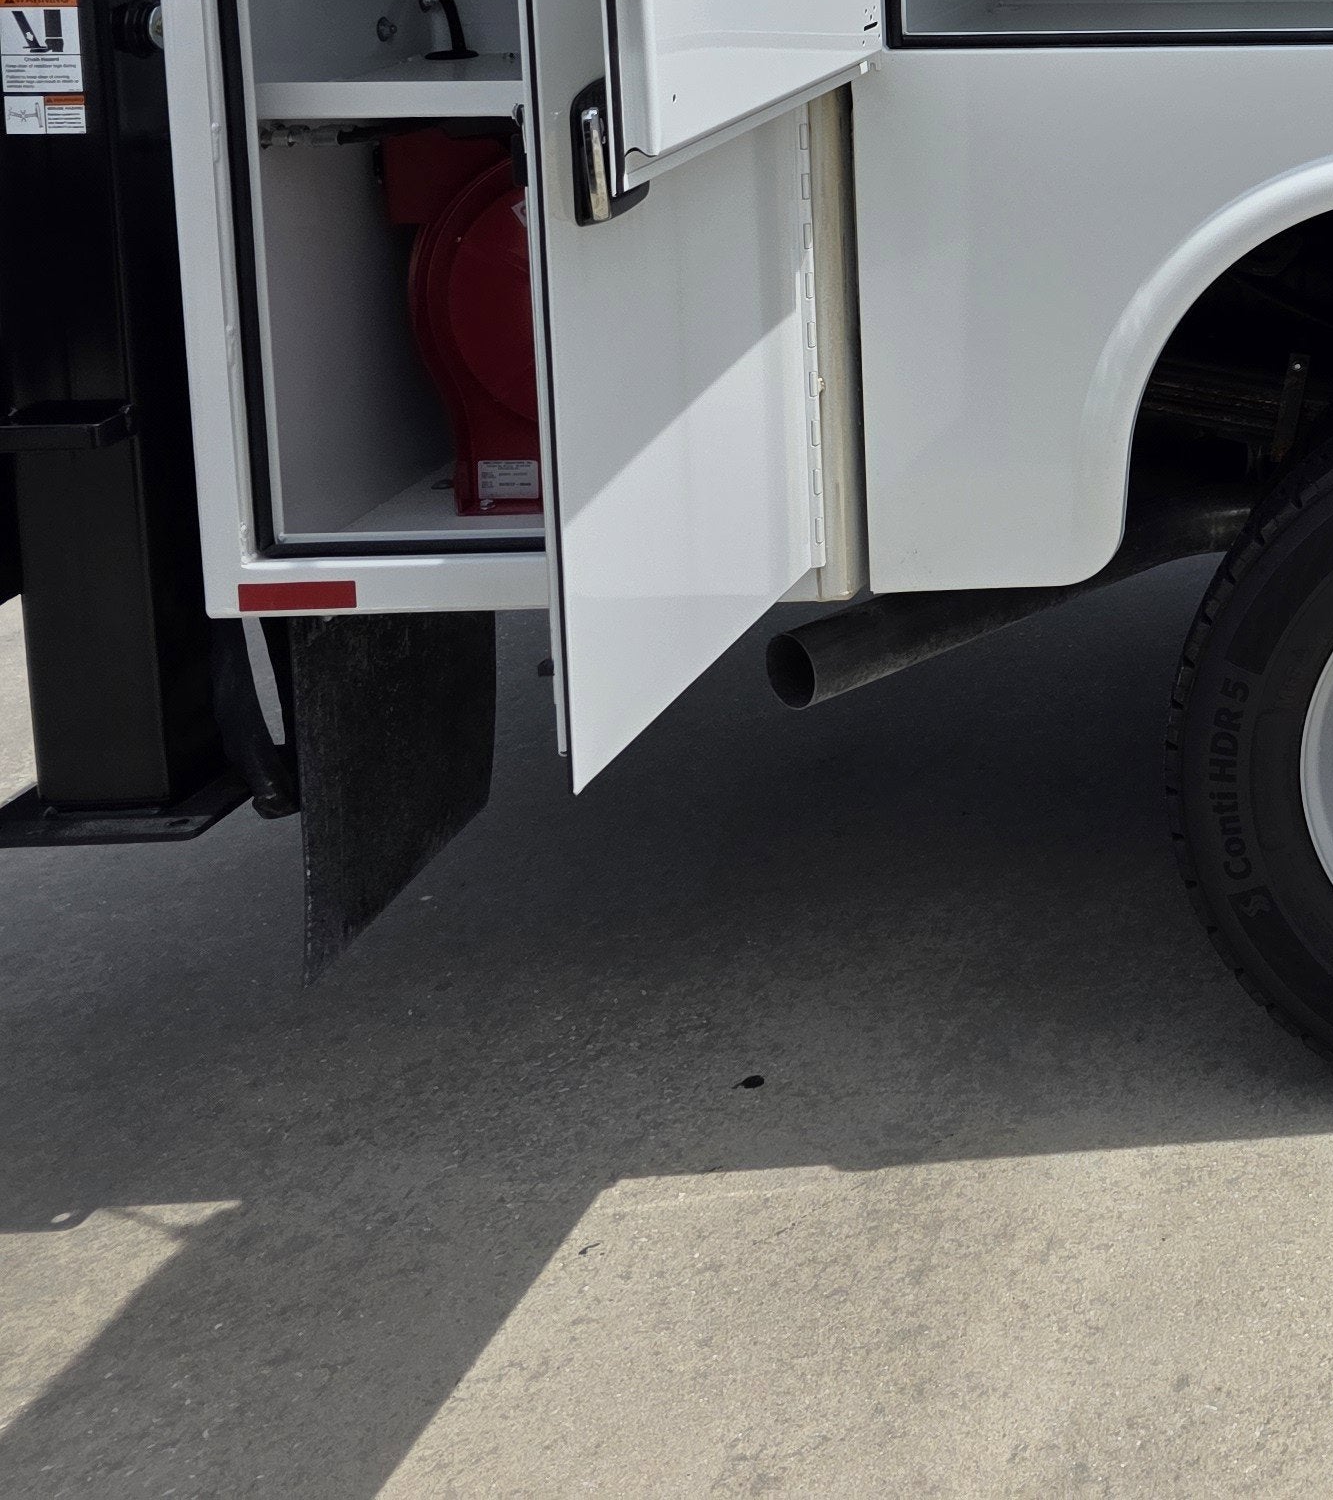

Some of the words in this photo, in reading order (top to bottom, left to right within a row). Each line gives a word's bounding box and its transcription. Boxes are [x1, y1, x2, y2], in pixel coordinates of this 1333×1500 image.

[1219, 677, 1250, 703] 5
[1208, 706, 1245, 783] HDR
[1208, 791, 1252, 881] Conti
